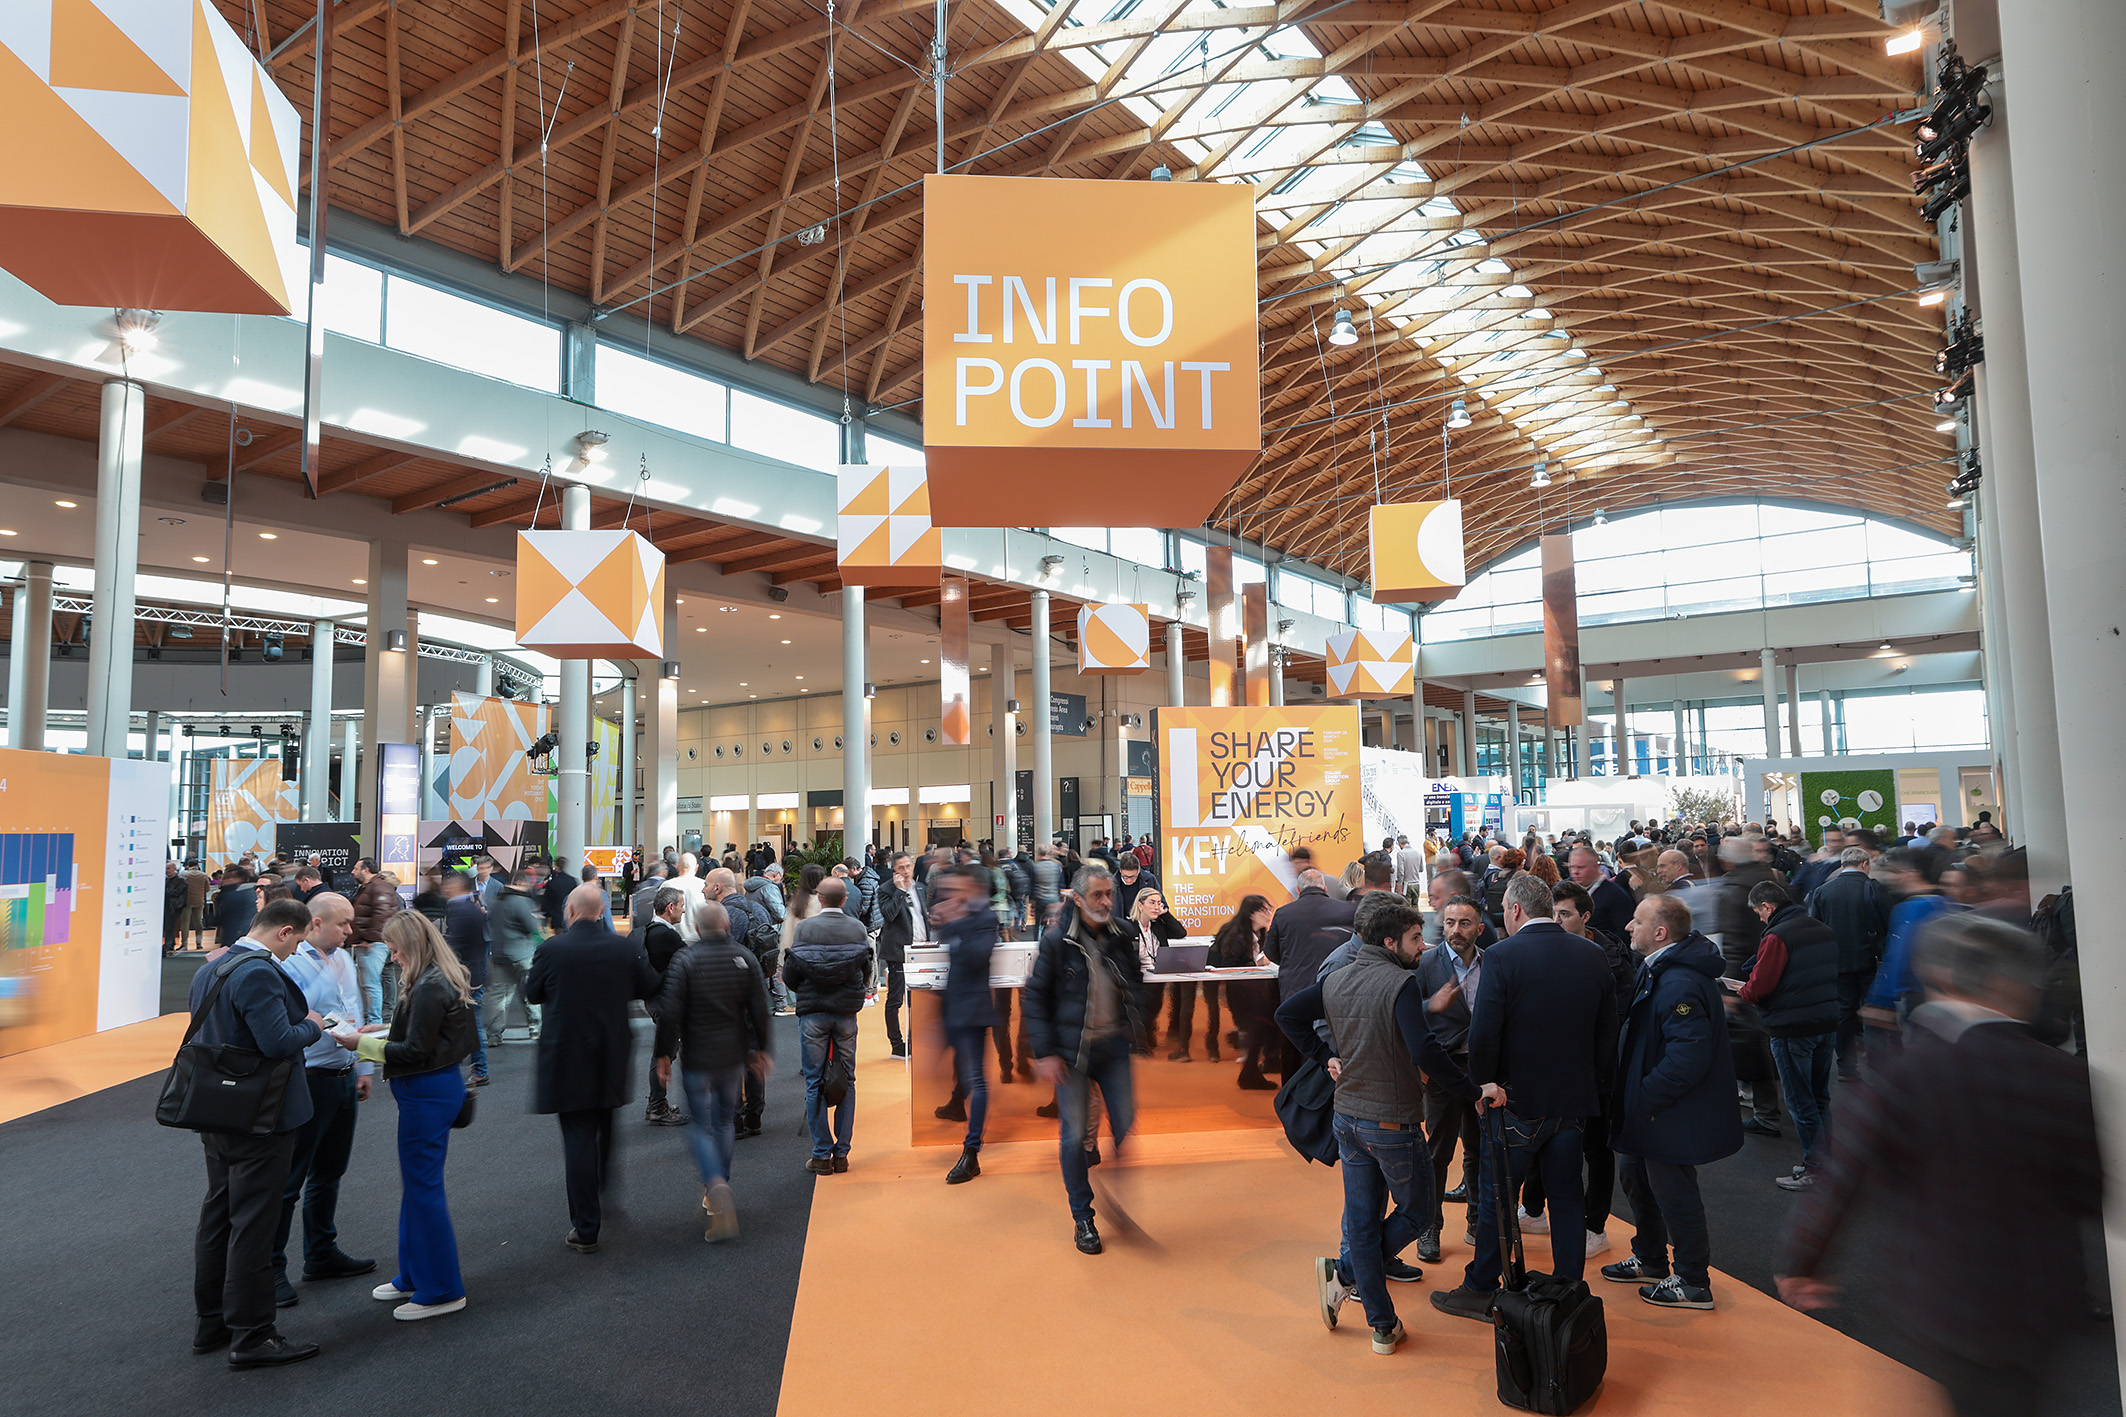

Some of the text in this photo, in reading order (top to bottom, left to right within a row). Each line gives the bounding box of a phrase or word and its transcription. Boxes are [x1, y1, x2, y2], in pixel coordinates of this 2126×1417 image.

[953, 274, 1174, 347] INFO
[956, 357, 1231, 429] POINT
[1210, 731, 1315, 759] SHARE
[1211, 761, 1296, 789] YOUR
[1432, 783, 1459, 792] ENEA
[215, 792, 237, 806] KEY
[1211, 790, 1334, 819] ENERGY
[293, 848, 349, 857] INNOVATION
[1172, 835, 1232, 876] KEY
[1173, 883, 1194, 894] THE
[1174, 894, 1215, 905] ENERGY
[1174, 905, 1236, 917] TRANSITION
